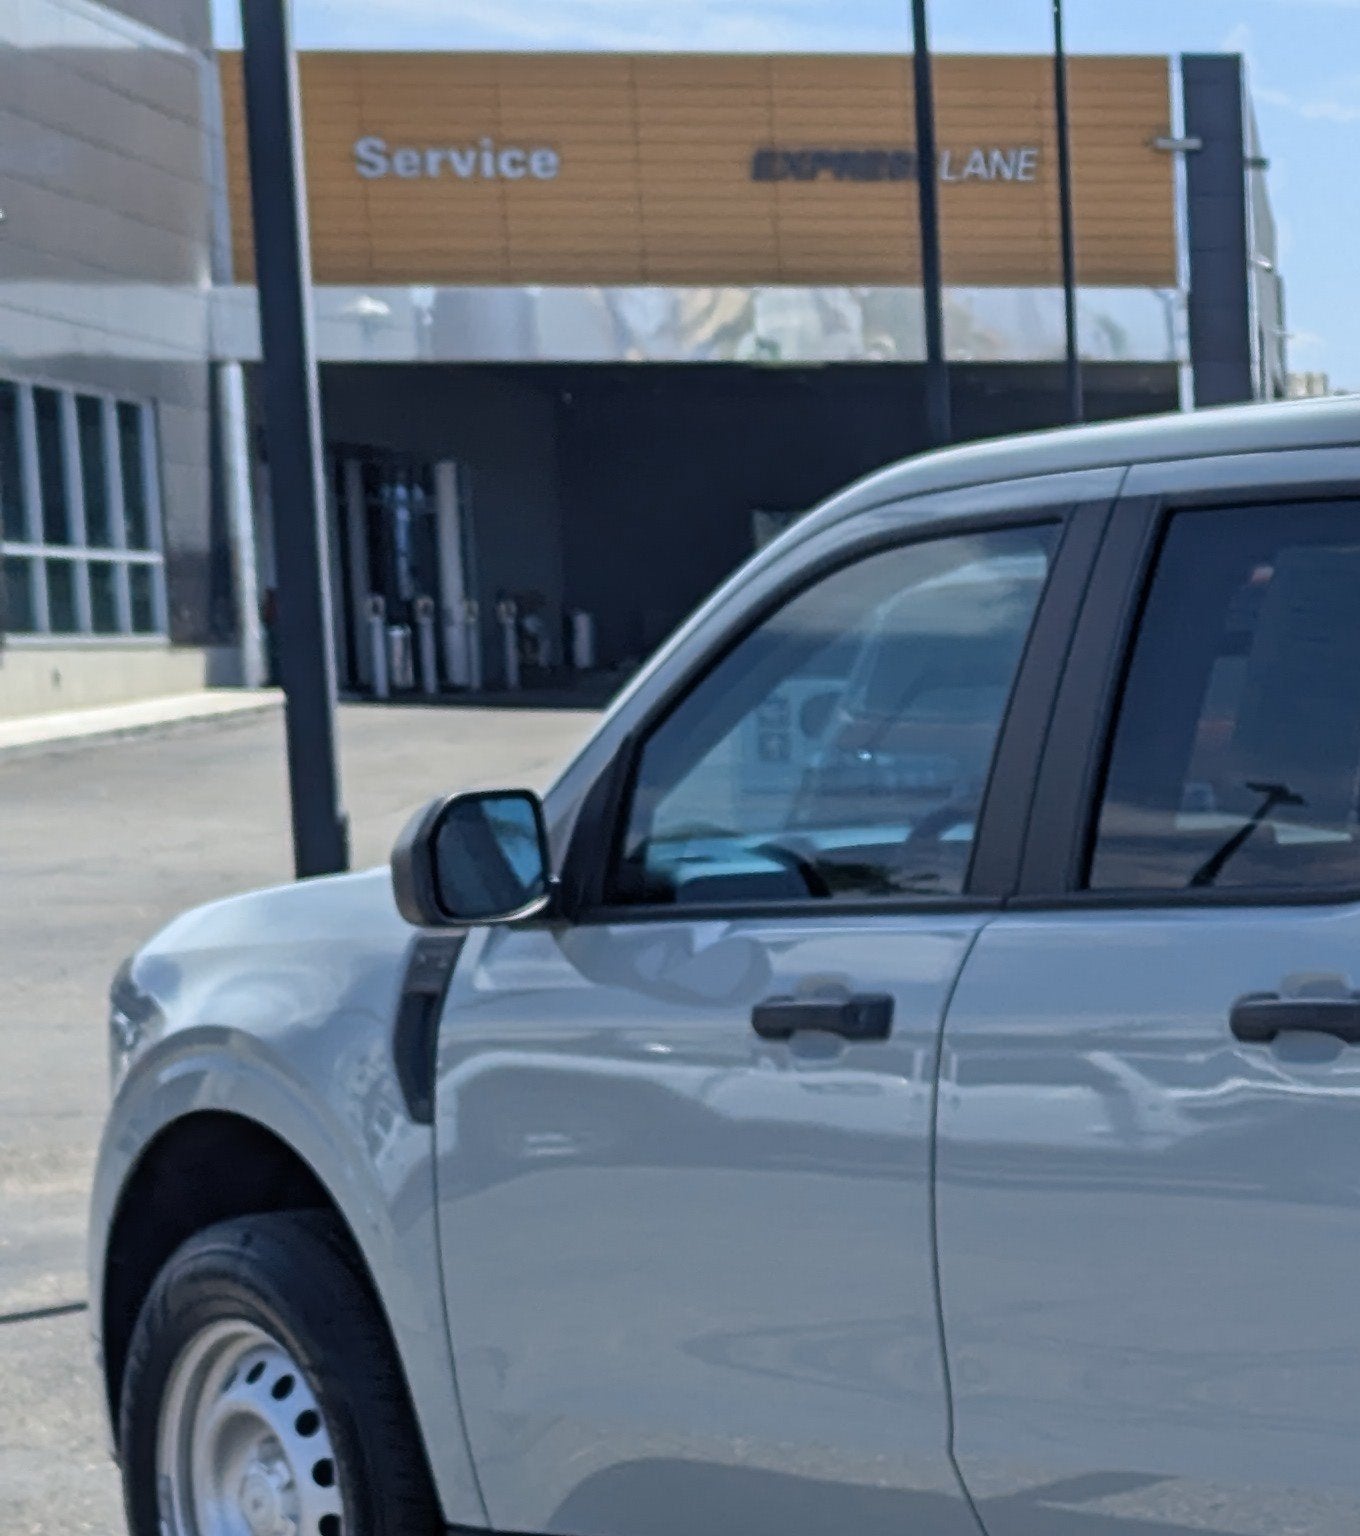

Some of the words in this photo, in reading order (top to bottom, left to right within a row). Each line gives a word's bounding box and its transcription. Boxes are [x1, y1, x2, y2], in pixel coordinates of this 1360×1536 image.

[354, 134, 561, 180] Service
[751, 149, 920, 181] EXPRES
[940, 148, 1038, 181] LANE
